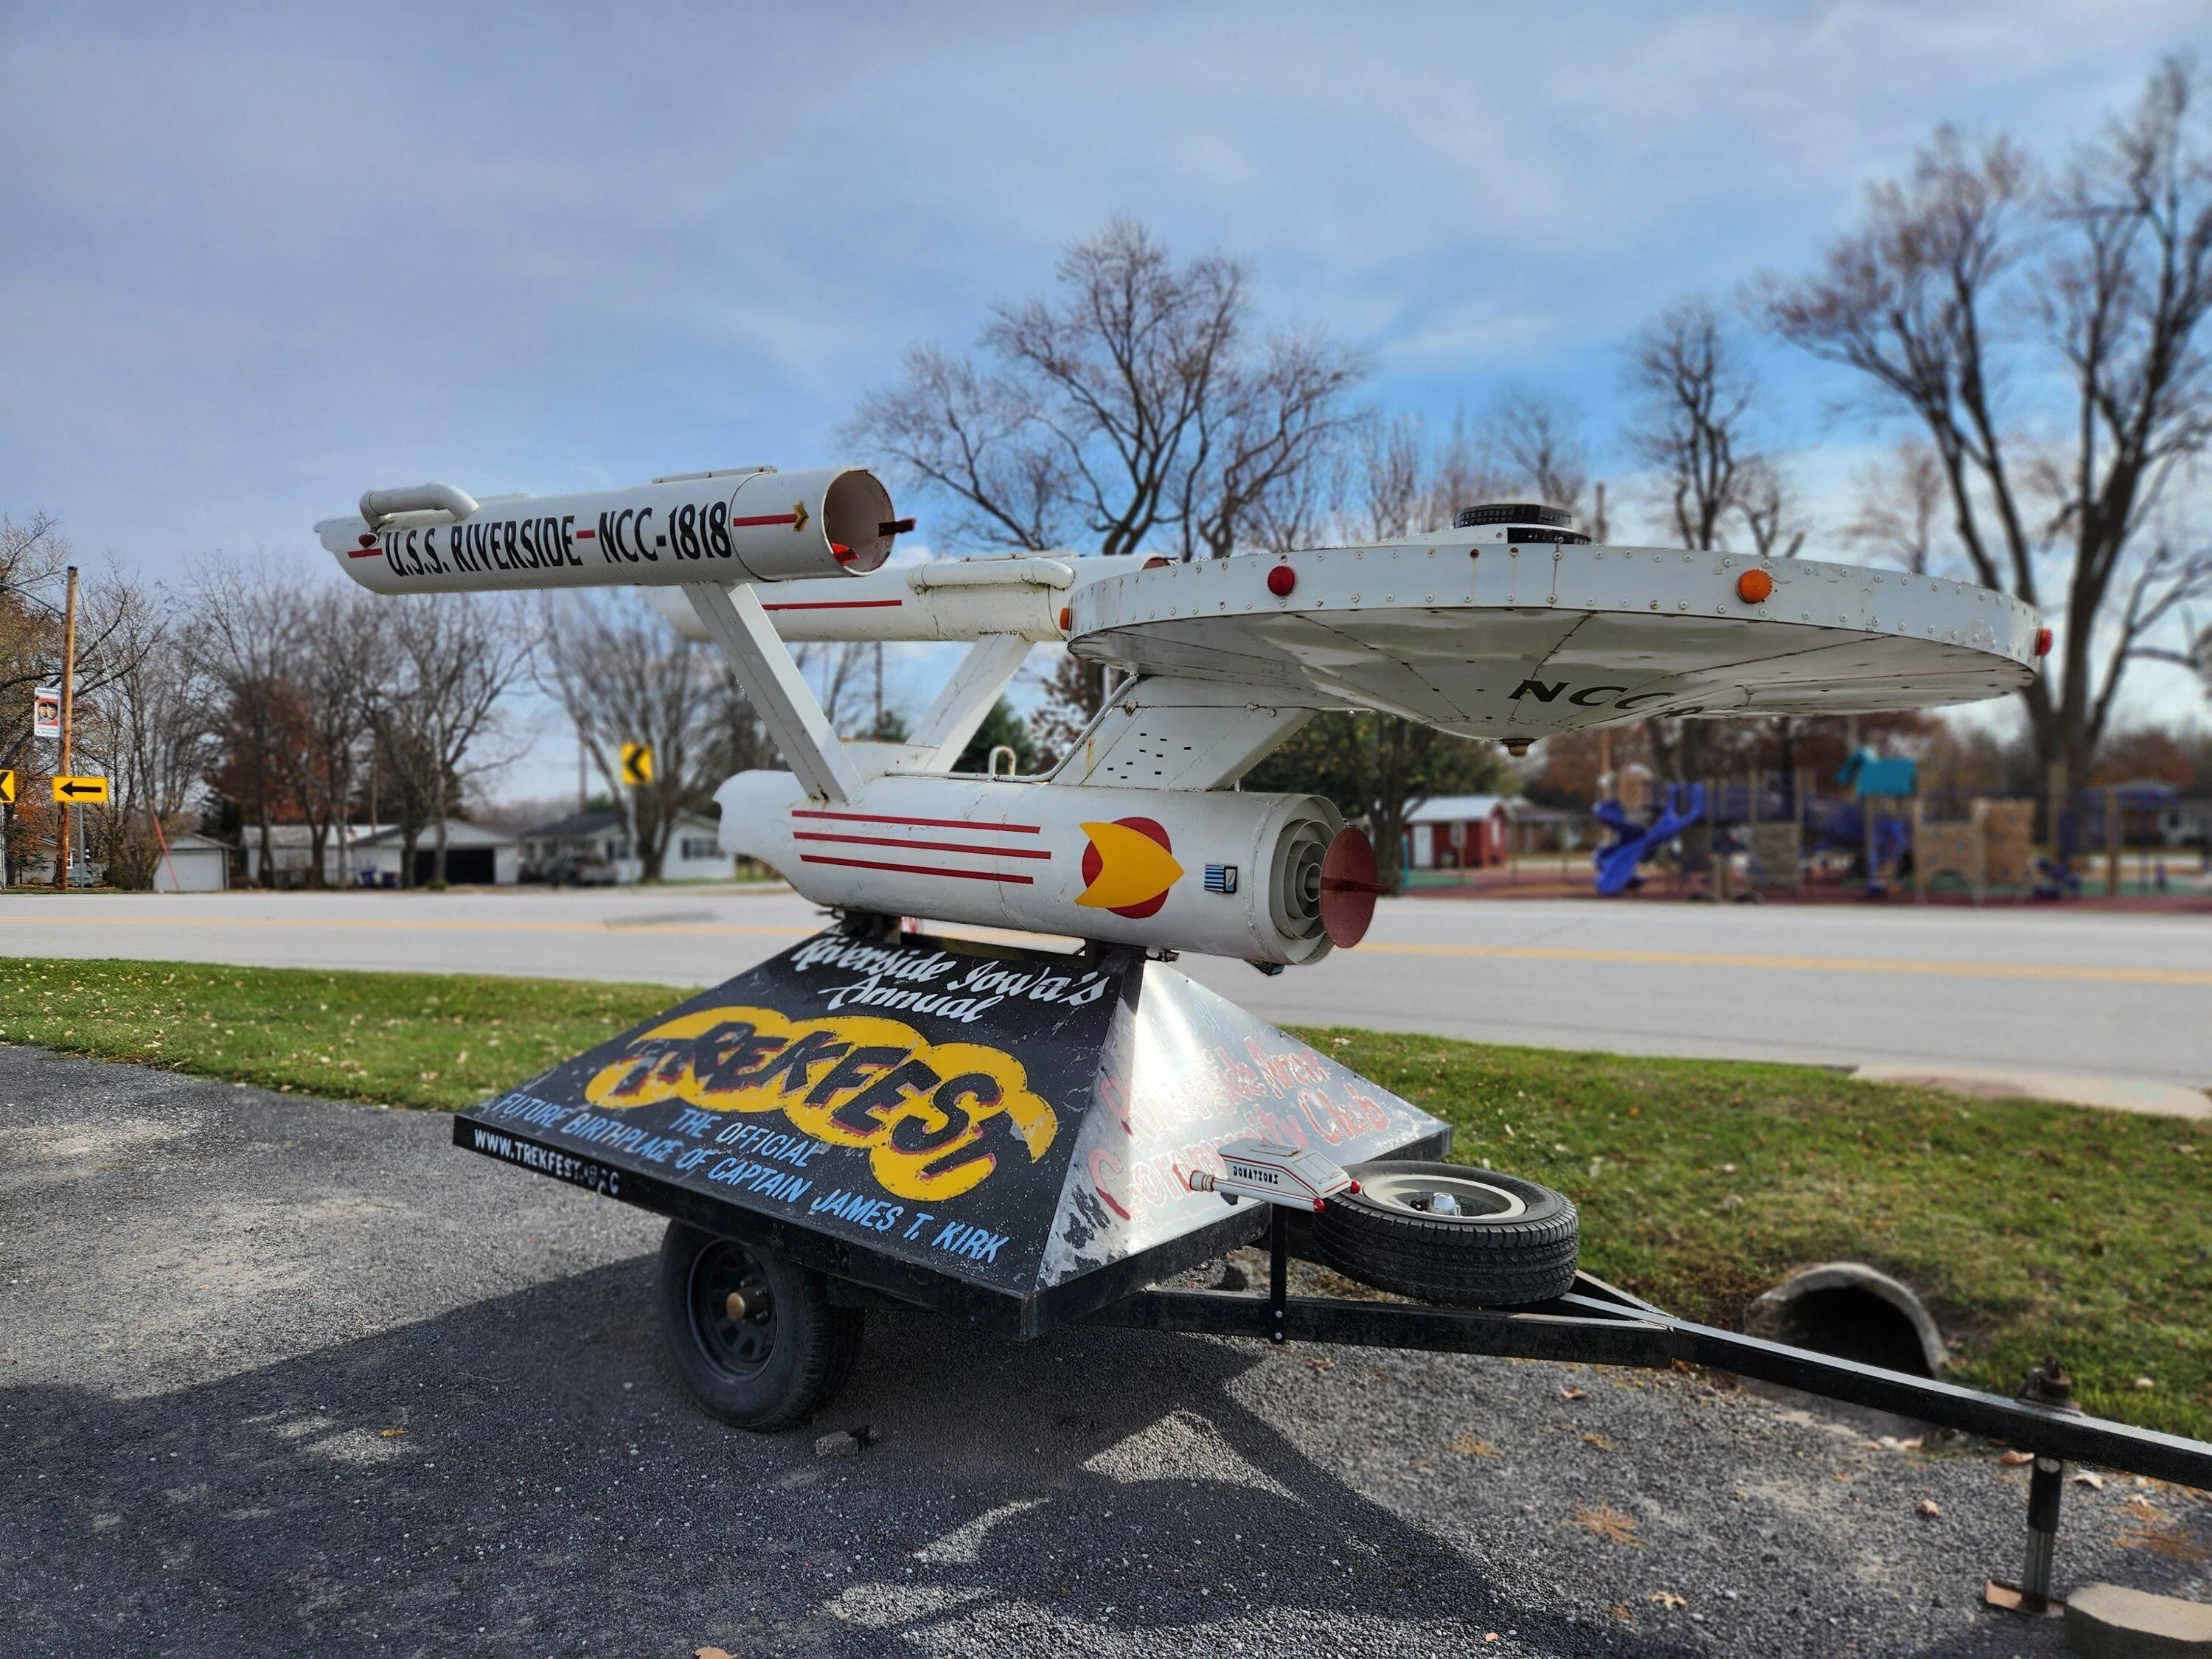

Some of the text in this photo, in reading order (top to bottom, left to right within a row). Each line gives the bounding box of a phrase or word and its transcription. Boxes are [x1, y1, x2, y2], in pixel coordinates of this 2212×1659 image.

[385, 501, 732, 577] U.S.S. RIVERSIDE NCC-1818
[790, 936, 1110, 1006] Riverside Iowa's
[817, 973, 1005, 1023] Annual
[613, 1021, 1034, 1183] TREKFEST
[669, 1108, 821, 1168] THE OFFICIAL
[493, 1093, 1010, 1264] FUTURE BIRTHPLACE OF CAPTAIN JAMES T. KIRK
[1233, 1166, 1279, 1185] DONATIONS
